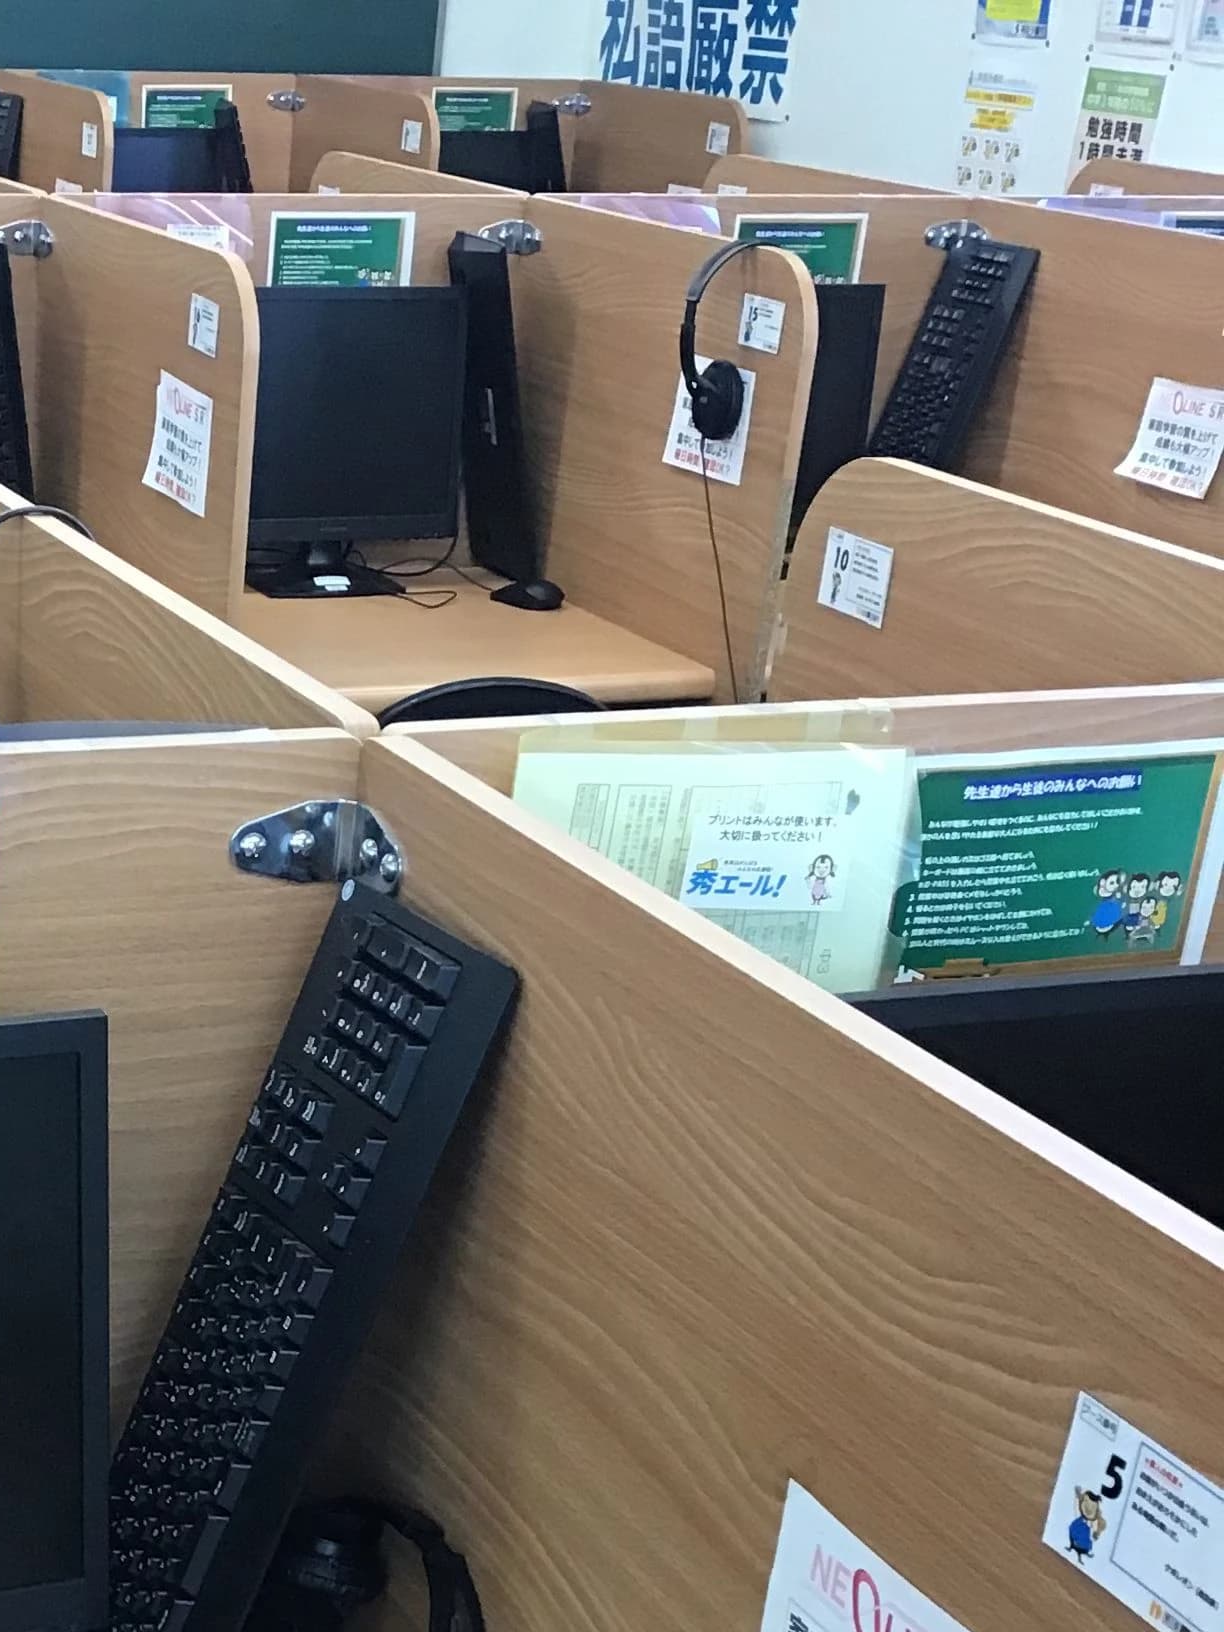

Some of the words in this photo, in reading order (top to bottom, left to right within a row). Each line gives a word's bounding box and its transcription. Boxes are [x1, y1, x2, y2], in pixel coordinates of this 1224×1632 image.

[834, 546, 849, 571] 10
[709, 814, 837, 827] プリントはみんなが使います。
[720, 830, 823, 842] 大切に扱ってください！
[1101, 1453, 1127, 1500] 5
